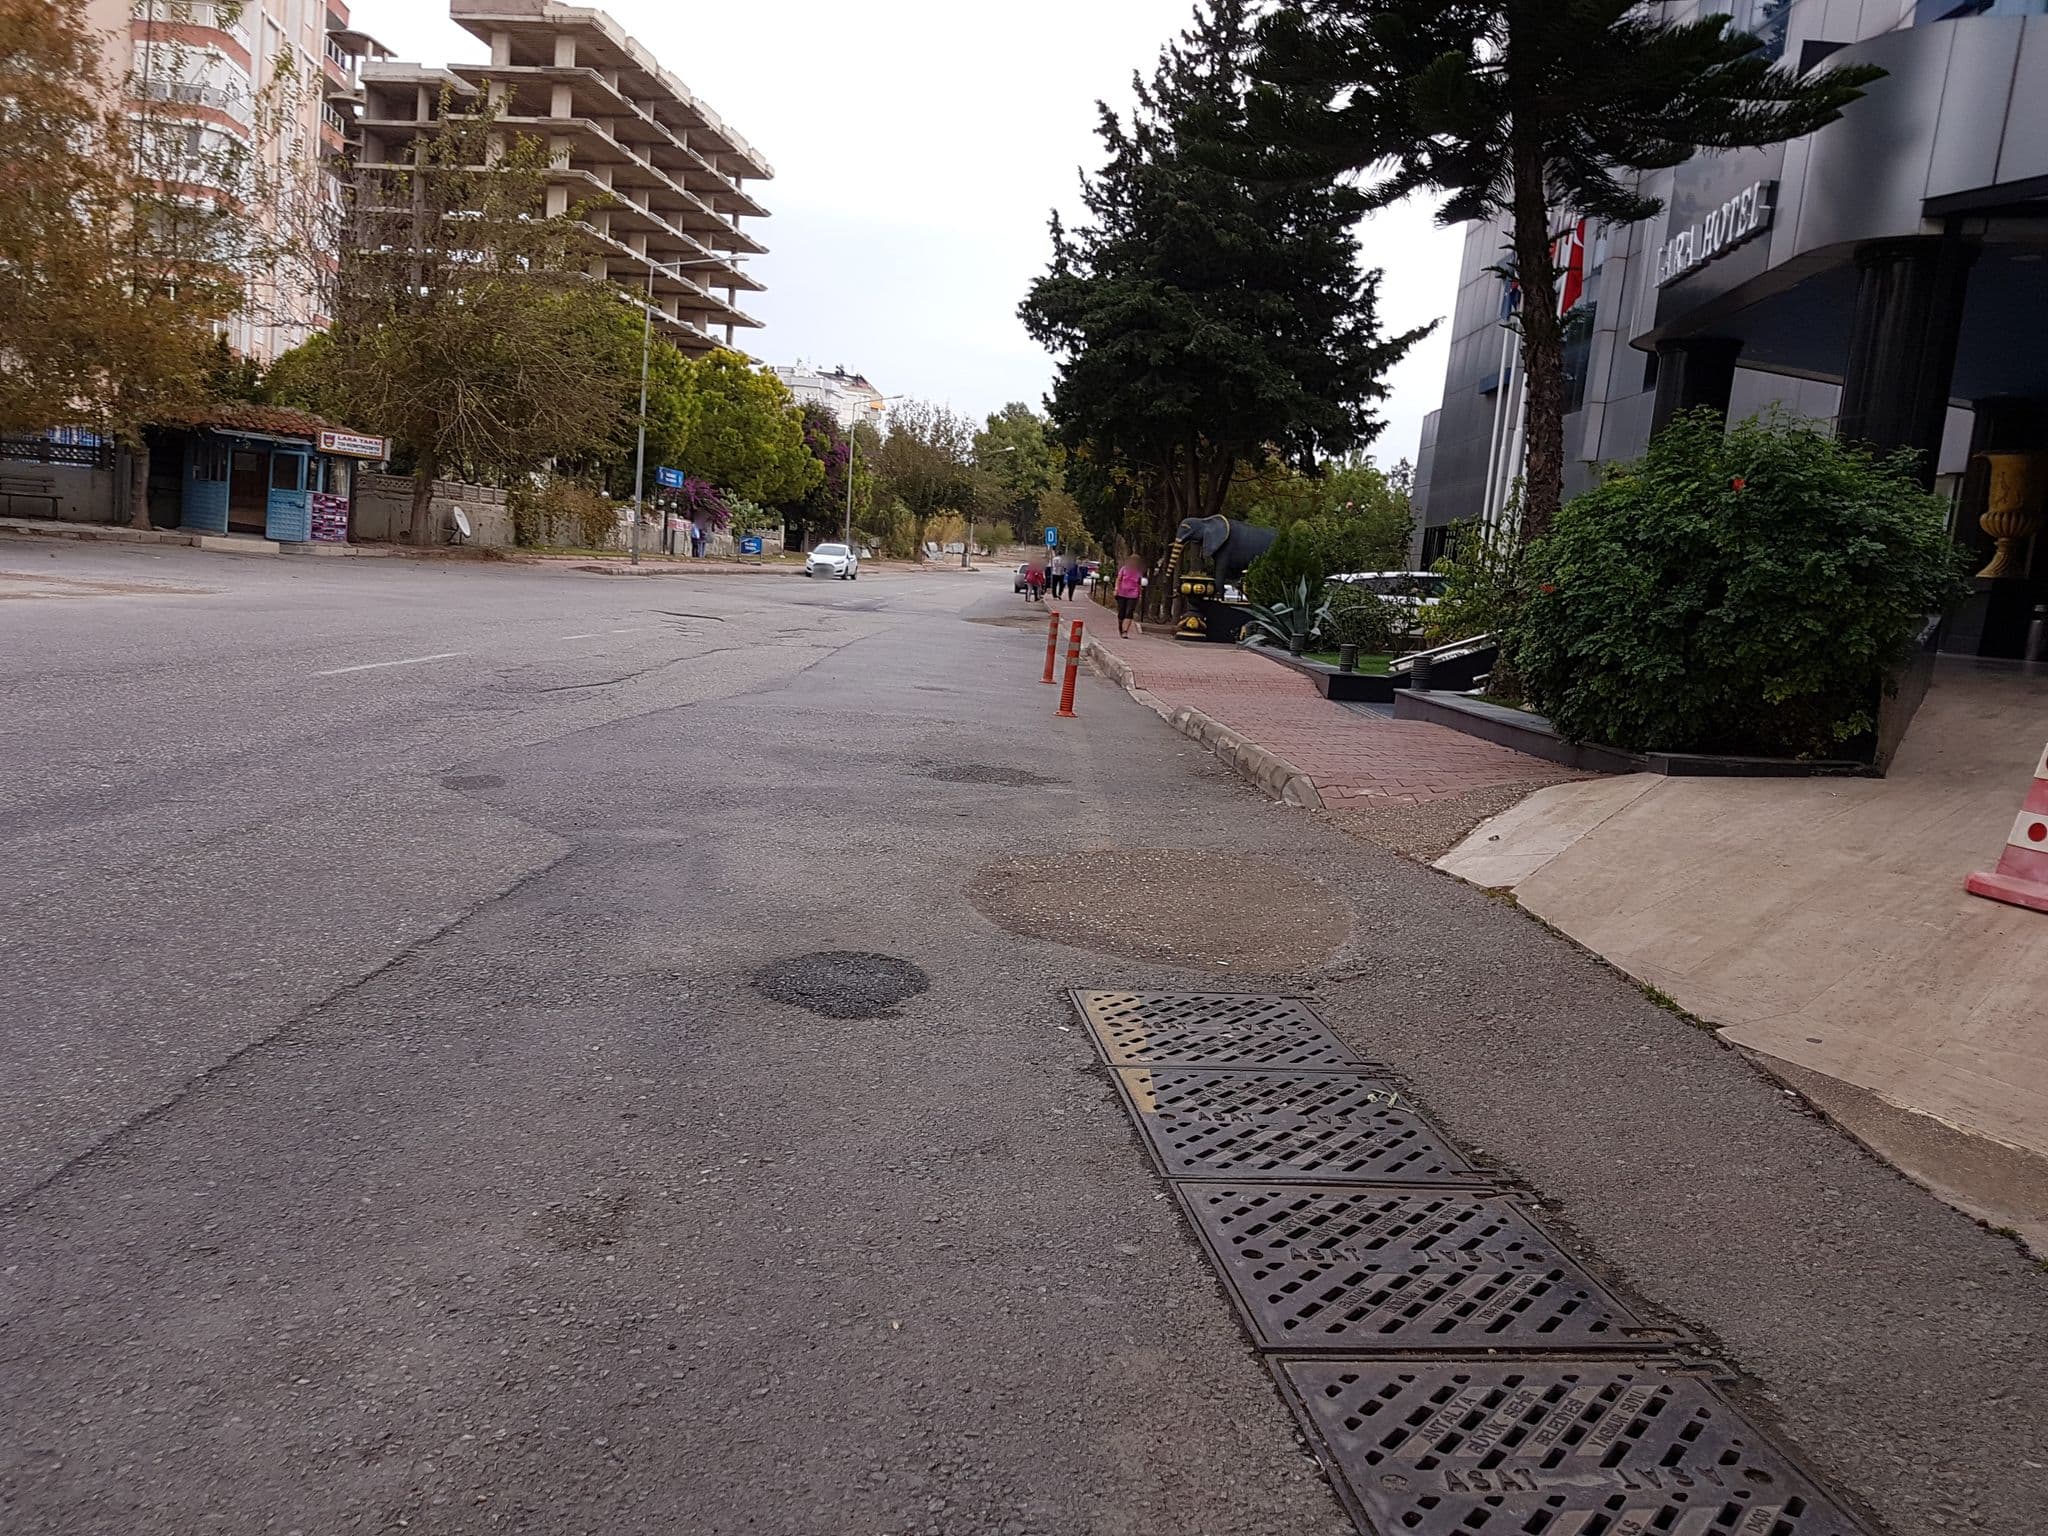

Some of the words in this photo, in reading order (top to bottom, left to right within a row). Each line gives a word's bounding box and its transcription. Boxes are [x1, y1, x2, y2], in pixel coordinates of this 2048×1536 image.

[1652, 224, 1695, 288] LARA
[1700, 180, 1761, 259] HOTEL
[337, 435, 357, 443] LARA
[1048, 530, 1054, 542] D
[1198, 1111, 1253, 1122] ASAT
[1290, 1246, 1361, 1262] ASAT
[1424, 1248, 1507, 1263] ASAT
[1440, 1292, 1467, 1309] 2010
[1619, 1390, 1647, 1413] SUYU
[1420, 1396, 1477, 1443] ANTALYA
[1444, 1468, 1538, 1492] ASAT
[1616, 1465, 1725, 1490] ASAT
[1743, 1508, 1772, 1534] D400
